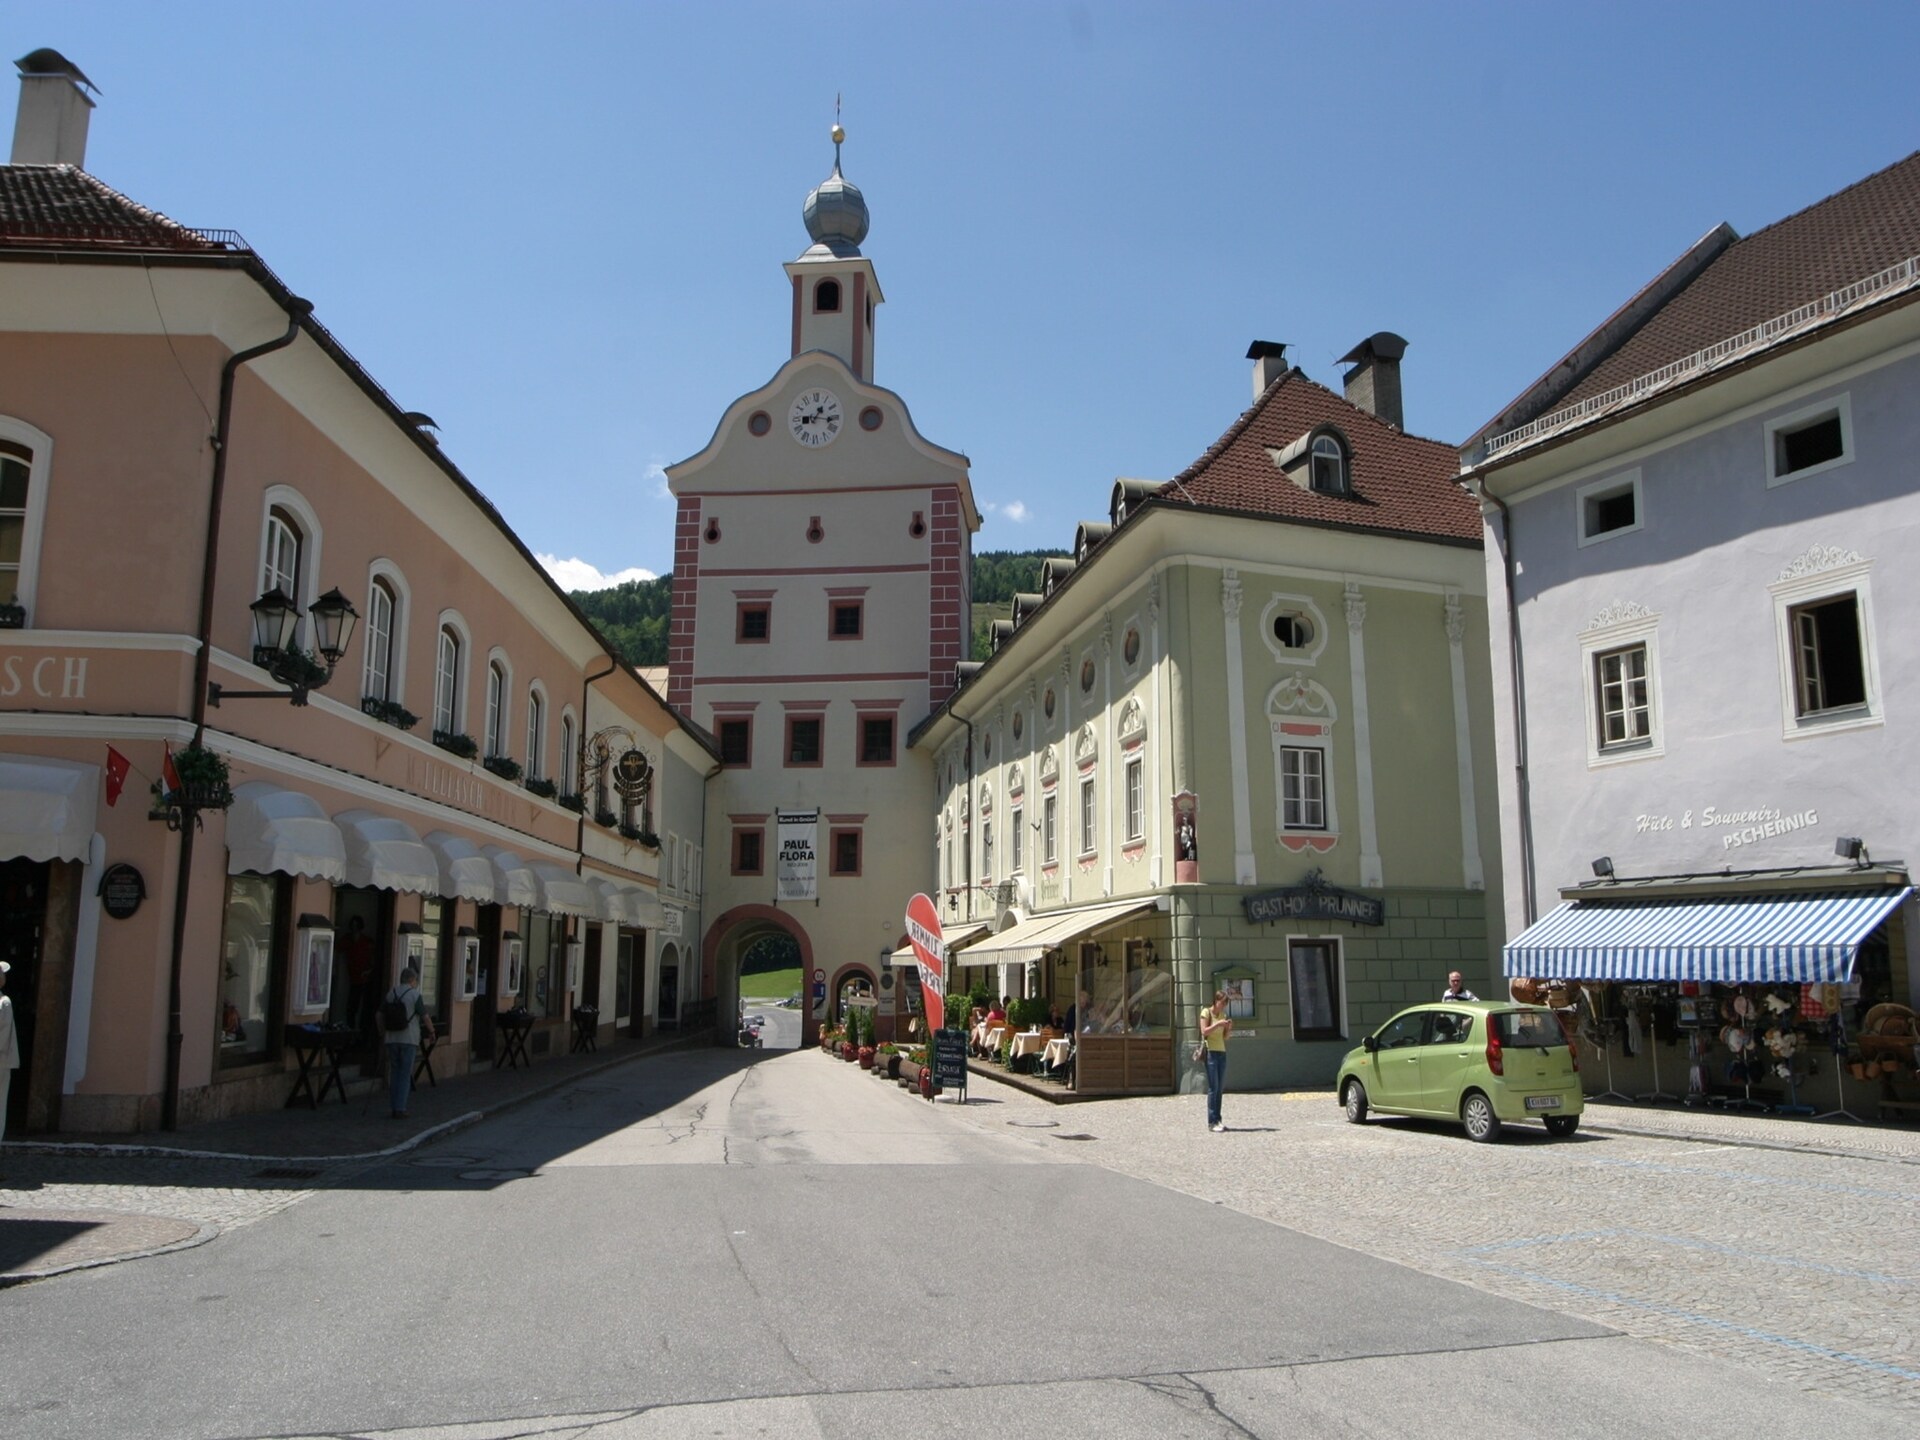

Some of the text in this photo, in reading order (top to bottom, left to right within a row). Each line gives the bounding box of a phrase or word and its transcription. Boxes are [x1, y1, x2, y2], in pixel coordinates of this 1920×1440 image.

[0, 655, 89, 698] SCH
[1636, 804, 1781, 833] Hüte & Souvenirs
[1723, 809, 1819, 850] PSCHERNIG
[780, 851, 815, 861] FLORA
[784, 840, 811, 850] PAUL
